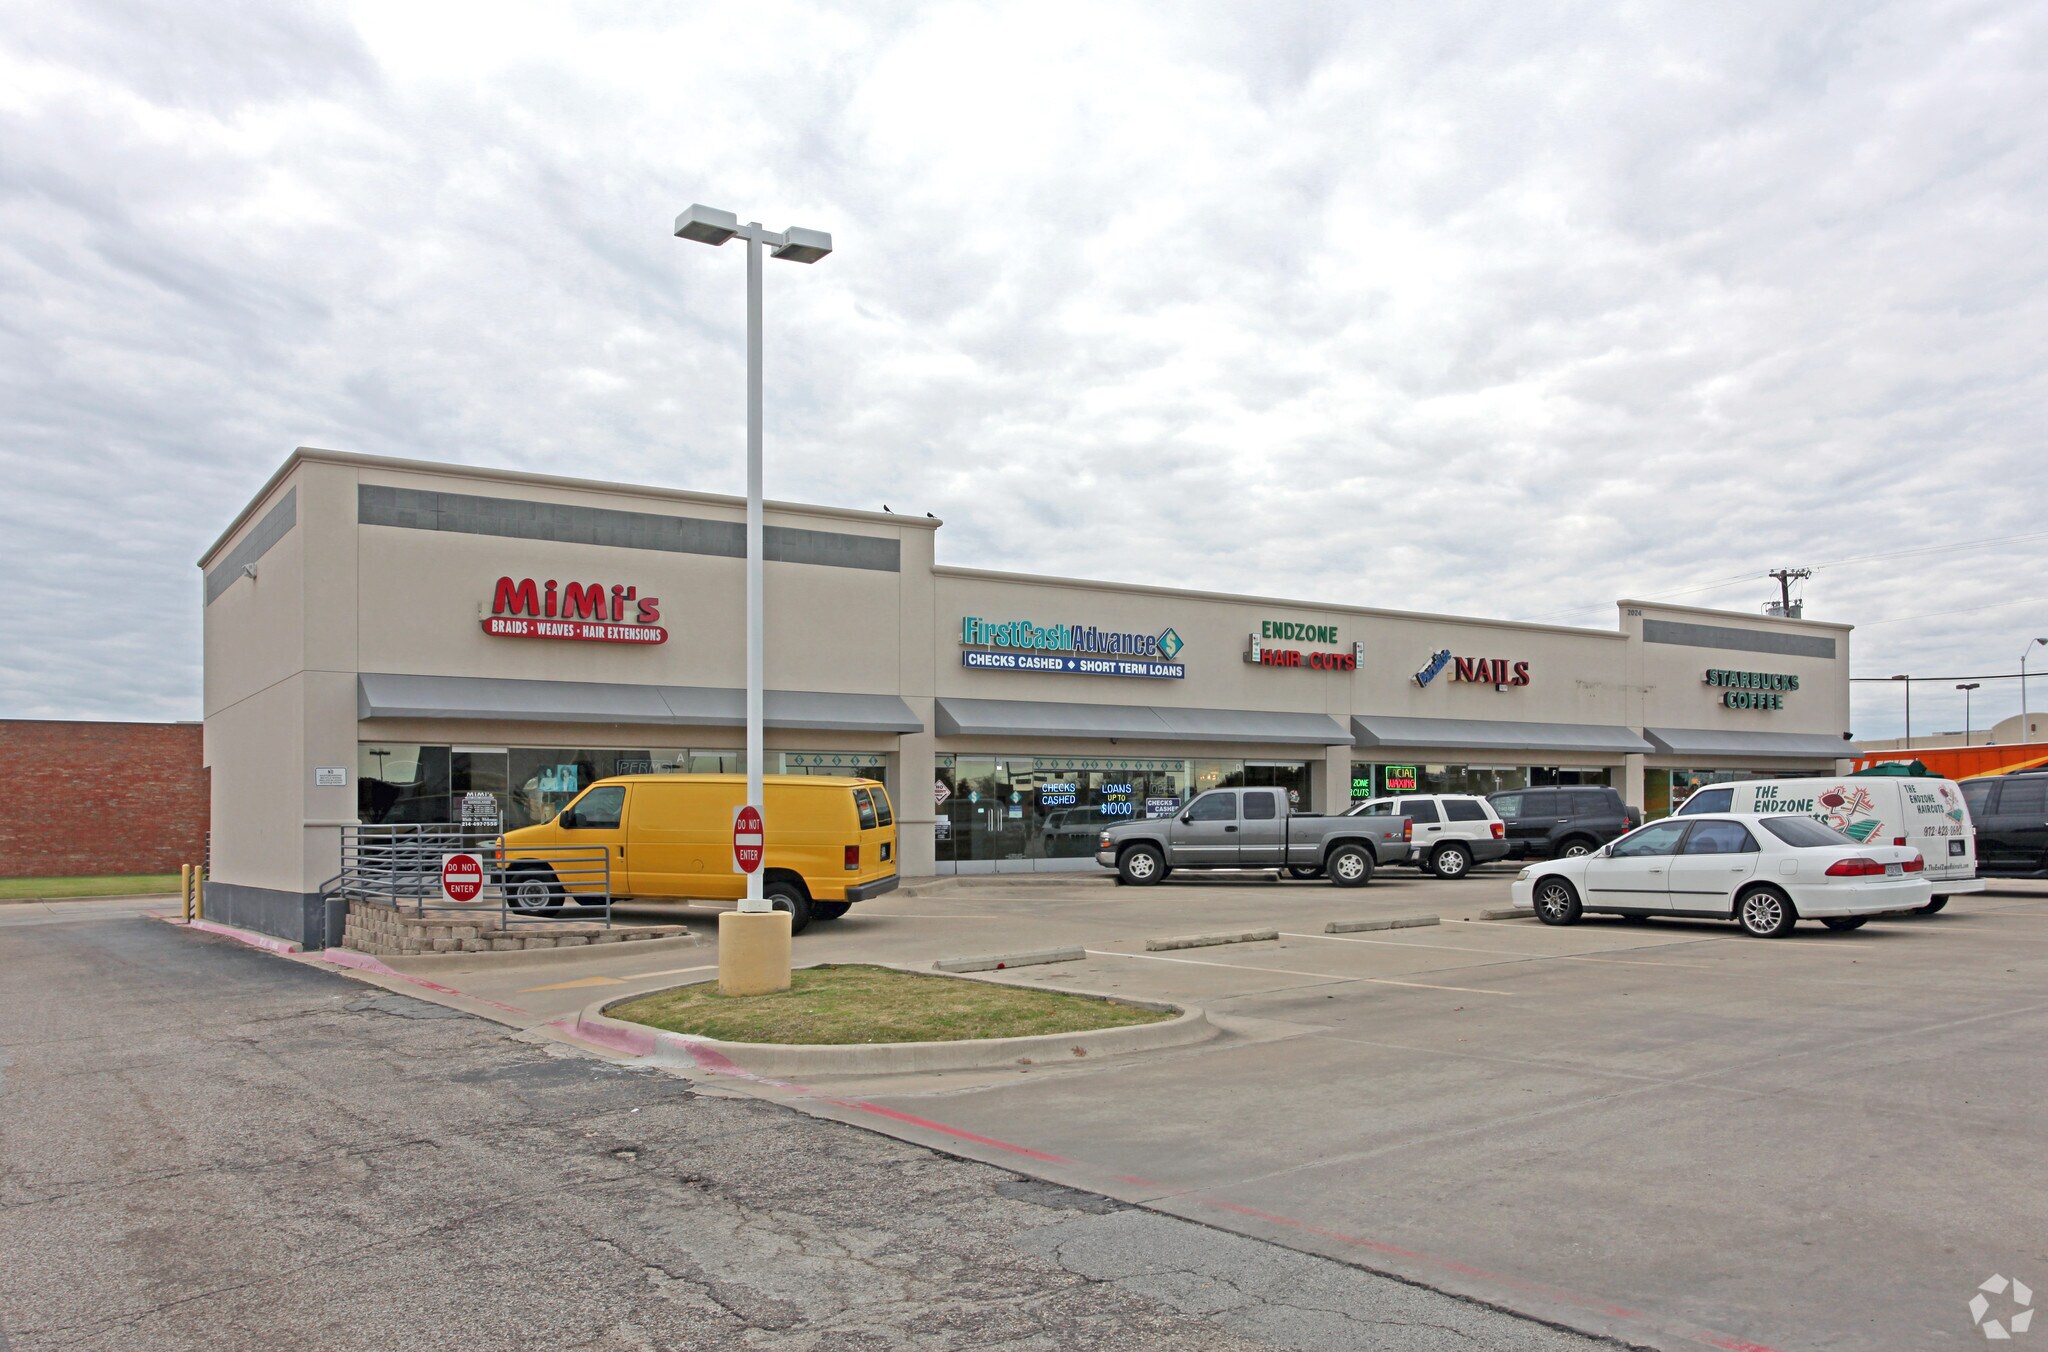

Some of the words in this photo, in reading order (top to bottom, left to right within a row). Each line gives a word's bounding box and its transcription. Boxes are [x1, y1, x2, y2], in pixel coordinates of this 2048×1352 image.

[492, 576, 660, 623] MiMi's
[1627, 608, 1642, 617] 2024
[491, 619, 528, 634] BRAIDS
[537, 622, 574, 637] WEAVES
[582, 625, 605, 639] HAIR
[607, 626, 661, 642] EXTENSIONS
[1262, 620, 1338, 644] ENDZONE
[968, 653, 1015, 667] CHECKS
[1018, 657, 1063, 670] CASHED
[1080, 660, 1116, 673] SHORT
[1119, 662, 1147, 675] TERM
[1150, 664, 1183, 677] LOANS
[1261, 648, 1302, 668] HAIR
[1310, 651, 1356, 671] CUTS
[1454, 656, 1530, 687] NAILS
[1707, 669, 1799, 691] STARBUCKS
[1726, 691, 1784, 710] COFFEE
[677, 752, 685, 763] A
[1461, 768, 1466, 776] E
[1041, 783, 1076, 793] CHECKS
[1352, 778, 1369, 787] ZONE
[1388, 778, 1415, 789] WAXING
[1101, 783, 1132, 794] LOANS
[1755, 786, 1778, 798] THE
[1903, 784, 1917, 793] THE
[1041, 794, 1076, 805] CASHED
[1107, 794, 1117, 802] UP
[1118, 794, 1126, 802] TO
[1909, 794, 1935, 804] ENDZONE
[1100, 802, 1132, 815] $1000
[1753, 799, 1814, 812] ENDZONE
[1916, 804, 1944, 814] HAIRCUTS
[737, 819, 746, 830] DO
[748, 819, 760, 830] NOT
[740, 849, 758, 861] ENTER
[447, 863, 458, 872] DO
[461, 863, 476, 872] NOT
[450, 884, 474, 893] ENTER
